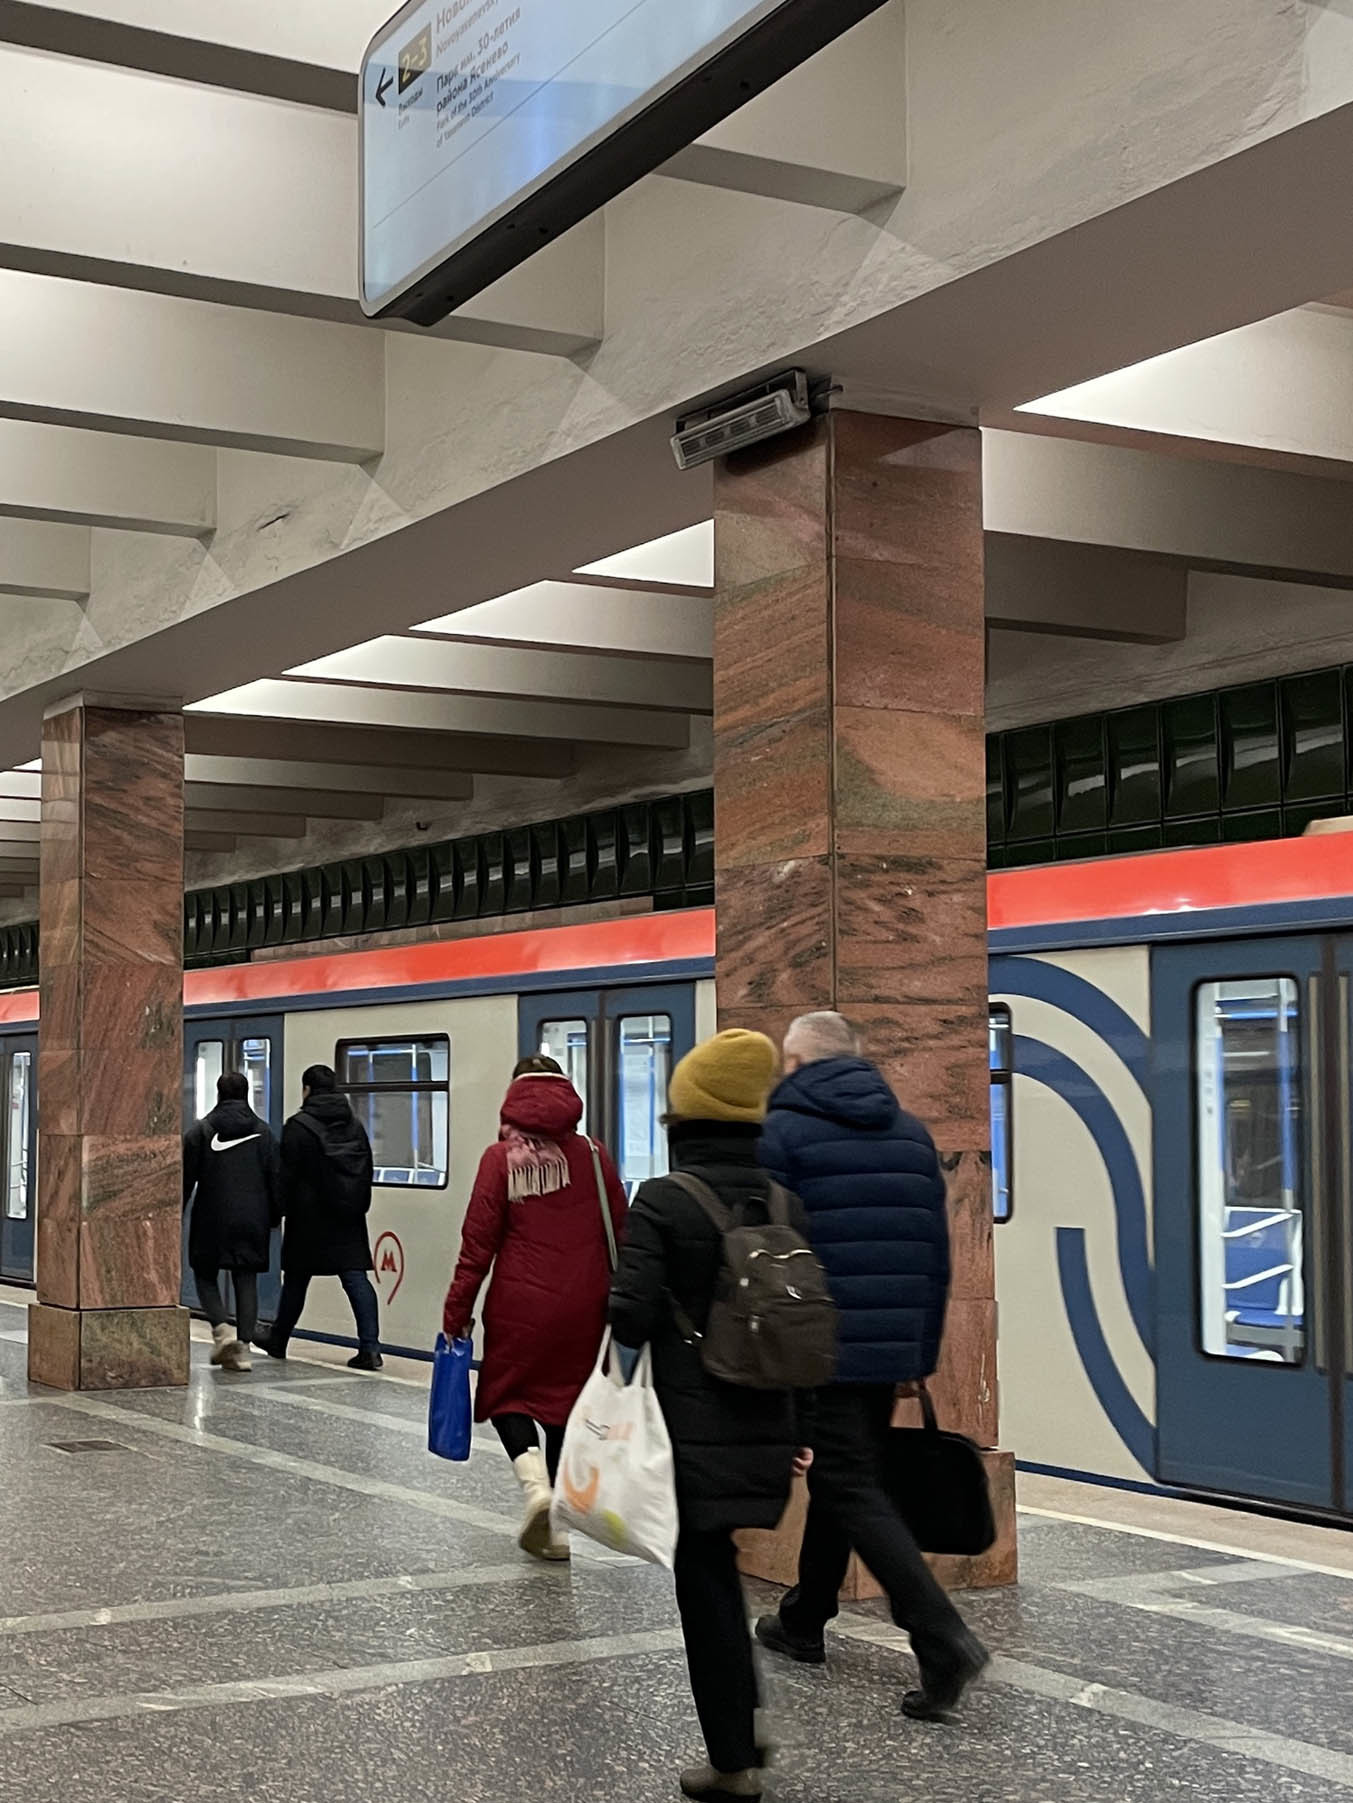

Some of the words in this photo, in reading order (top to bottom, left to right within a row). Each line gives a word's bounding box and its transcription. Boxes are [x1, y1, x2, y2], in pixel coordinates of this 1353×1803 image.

[436, 78, 467, 112] района
[469, 41, 509, 84] Ясенево
[436, 62, 459, 93] Парк
